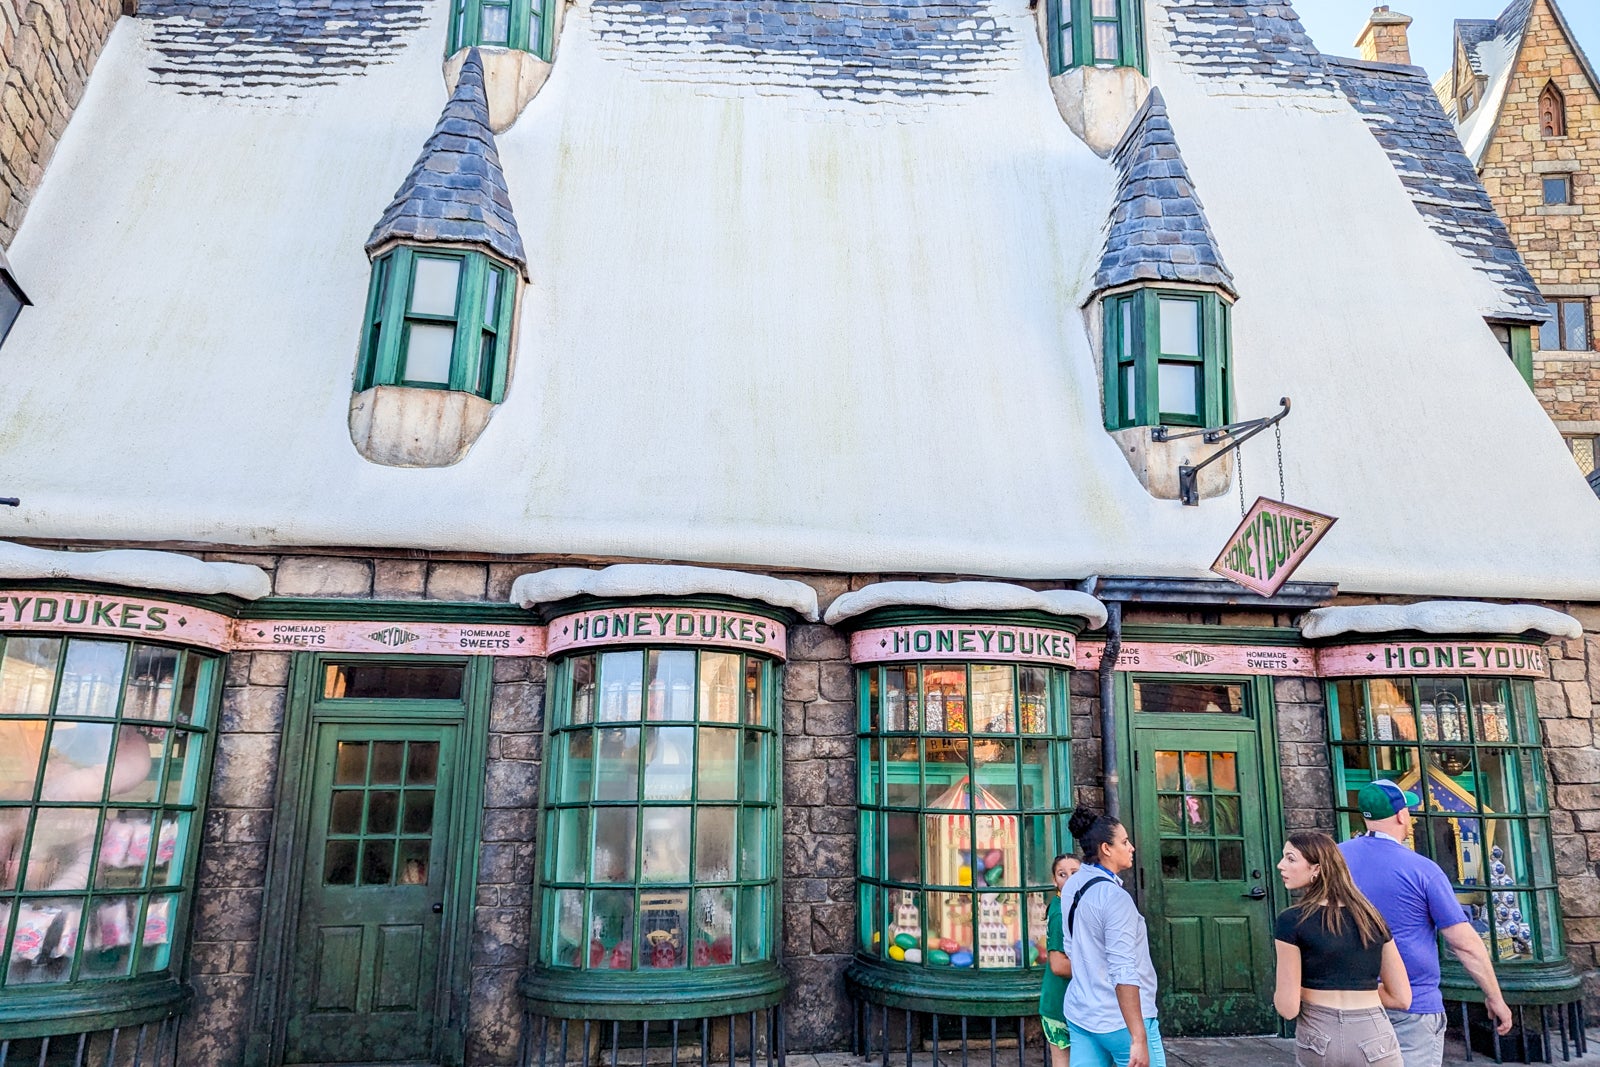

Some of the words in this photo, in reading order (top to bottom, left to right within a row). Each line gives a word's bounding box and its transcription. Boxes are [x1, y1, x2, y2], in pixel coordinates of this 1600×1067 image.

[1224, 511, 1313, 580] HONEYDUKES
[273, 625, 326, 633] HOMEMADE
[460, 629, 511, 638] HOMEMADE
[573, 613, 767, 644] HONEYDUKES
[273, 634, 325, 645] SWEETS
[368, 627, 420, 647] HONEYDUKES
[459, 638, 510, 649] SWEETS
[894, 629, 1071, 659] HONEYDUKES
[1097, 647, 1140, 655] HMADE
[1246, 651, 1287, 659] HOMEMADE
[1172, 649, 1215, 667] HONEYDUKES
[1384, 646, 1543, 670] HONEYDUKE
[1247, 659, 1288, 669] SWEETS
